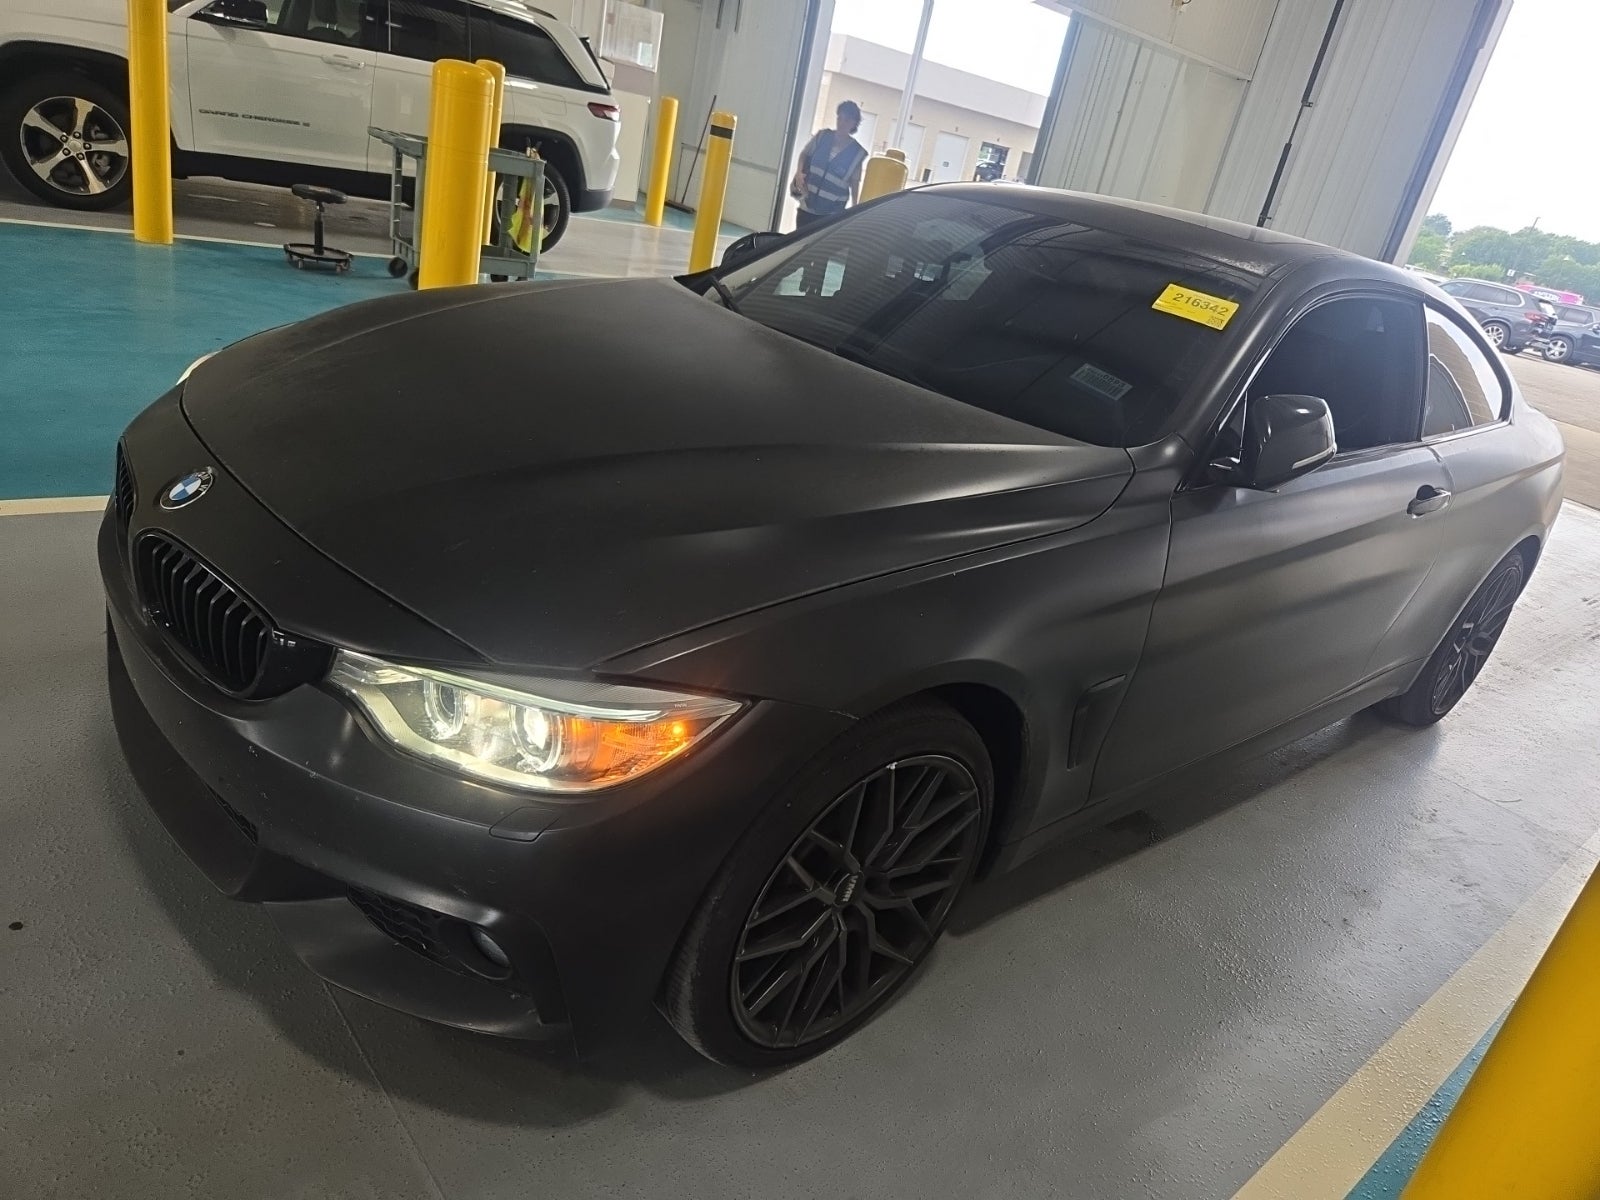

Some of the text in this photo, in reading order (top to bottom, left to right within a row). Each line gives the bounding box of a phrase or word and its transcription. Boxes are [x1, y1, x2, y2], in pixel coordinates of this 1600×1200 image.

[198, 108, 239, 117] GRAND
[241, 114, 301, 125] CHEROKEE
[1172, 293, 1230, 317] 216342
